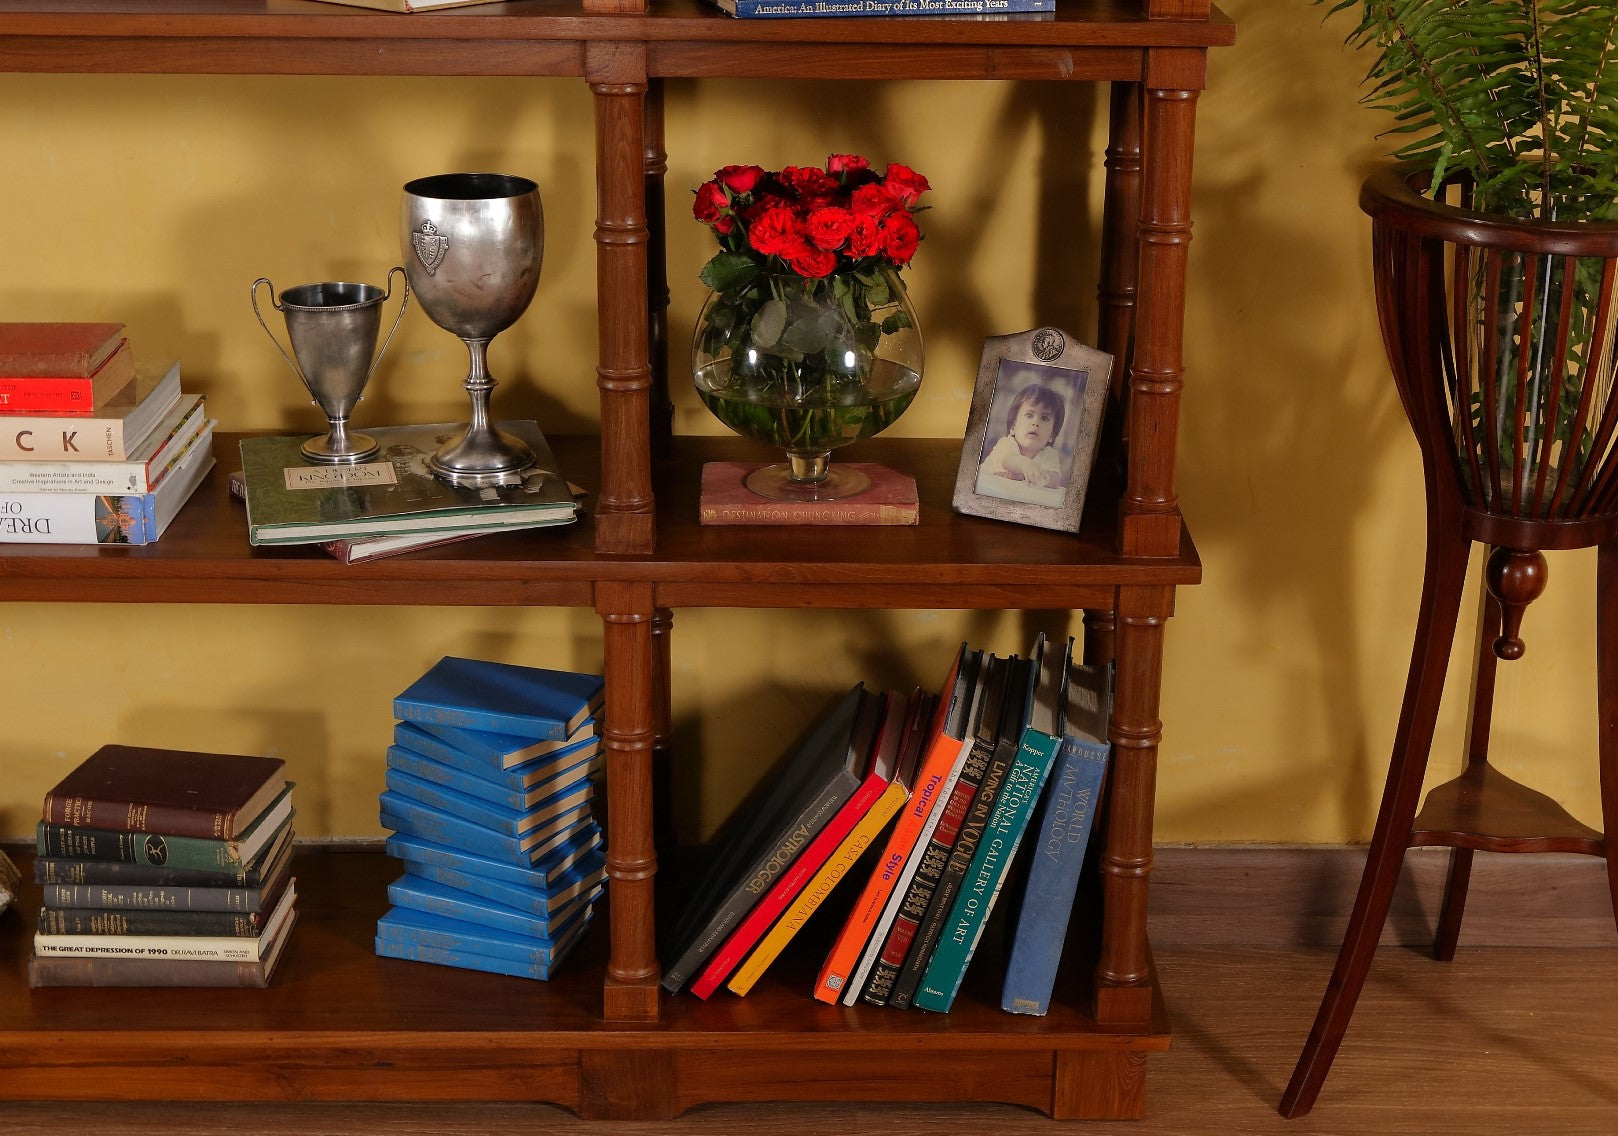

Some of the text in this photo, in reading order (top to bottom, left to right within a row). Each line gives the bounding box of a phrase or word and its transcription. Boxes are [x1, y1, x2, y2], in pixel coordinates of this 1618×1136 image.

[755, 0, 1009, 14] America: An Illustrated Diary of Its Most Exciting Years
[106, 427, 114, 457] TASCHEN
[722, 509, 789, 521] DESTINATION
[792, 509, 857, 521] CHUNGKING
[1022, 743, 1045, 757] Kopper
[947, 768, 958, 783] the
[1009, 768, 1020, 783] Gift
[1023, 767, 1038, 803] AMERICA'S
[937, 787, 950, 808] force
[1000, 792, 1010, 803] the
[949, 761, 1005, 875] LIVING IN VOGUE
[991, 803, 1005, 828] Nation
[1045, 764, 1077, 862] MYTHOLOGY
[1068, 788, 1091, 844] WORLD
[882, 774, 943, 882] Tropical Asian Style
[745, 824, 809, 894] ASTROLOGER
[844, 834, 869, 861] CASA
[953, 763, 1034, 944] NATIONAL GALLERY OF ART
[786, 863, 846, 930] COLOMBIANA
